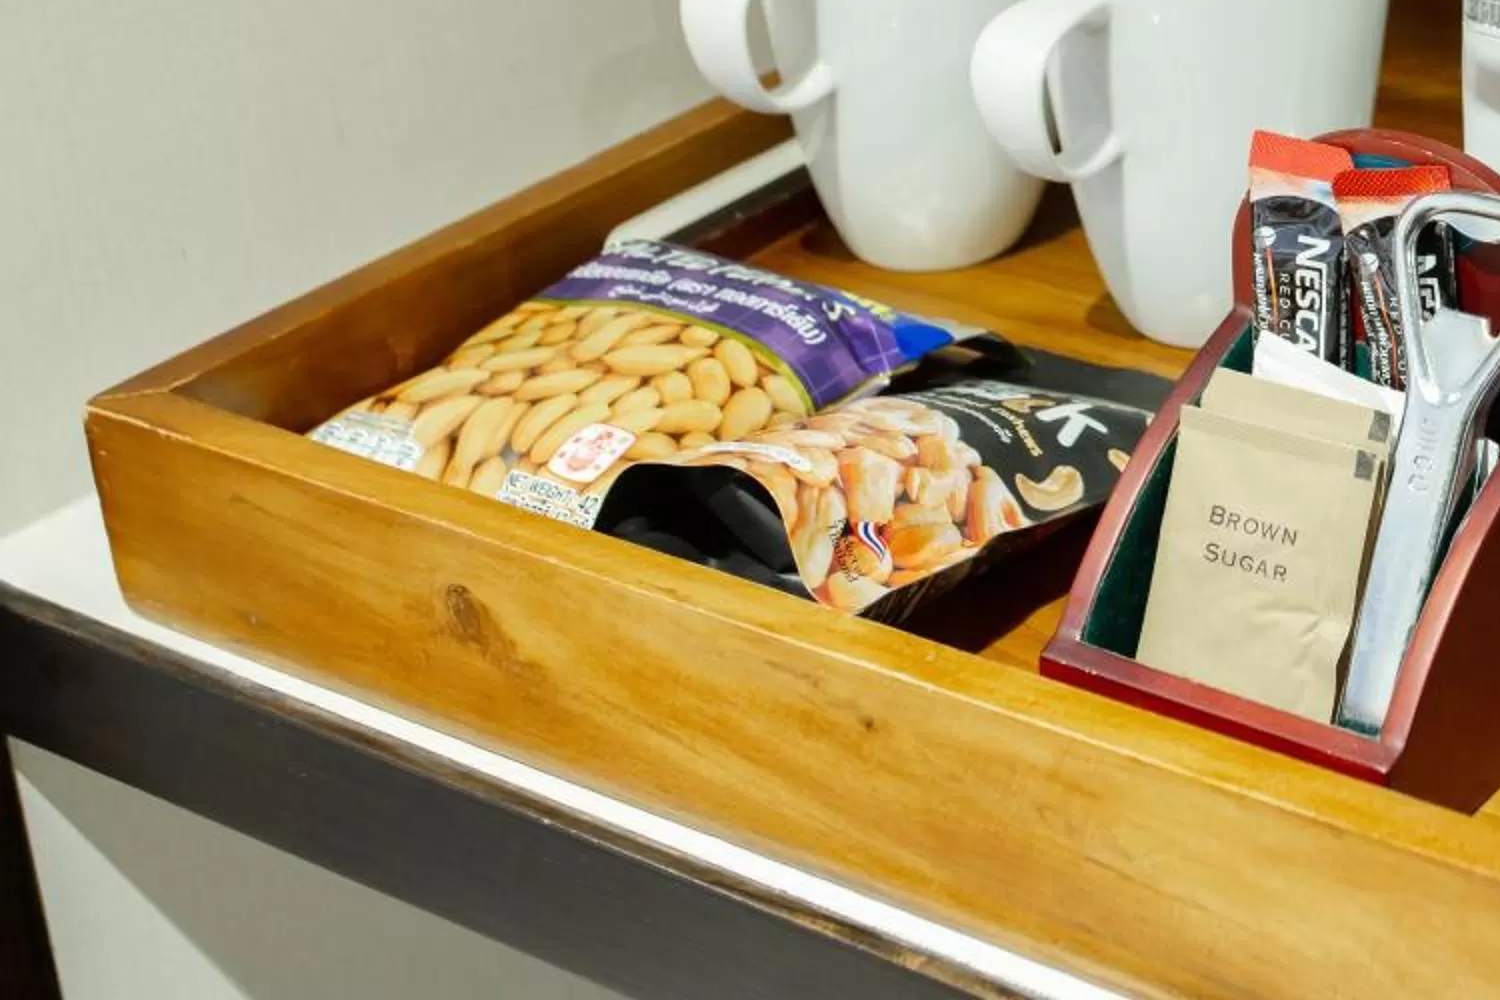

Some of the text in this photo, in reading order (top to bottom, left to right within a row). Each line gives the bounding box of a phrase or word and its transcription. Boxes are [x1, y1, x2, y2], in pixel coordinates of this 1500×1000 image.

[1279, 272, 1292, 309] RED
[1294, 234, 1332, 354] NESCA
[1209, 504, 1297, 546] BROWN
[1203, 542, 1288, 582] SUGAR
